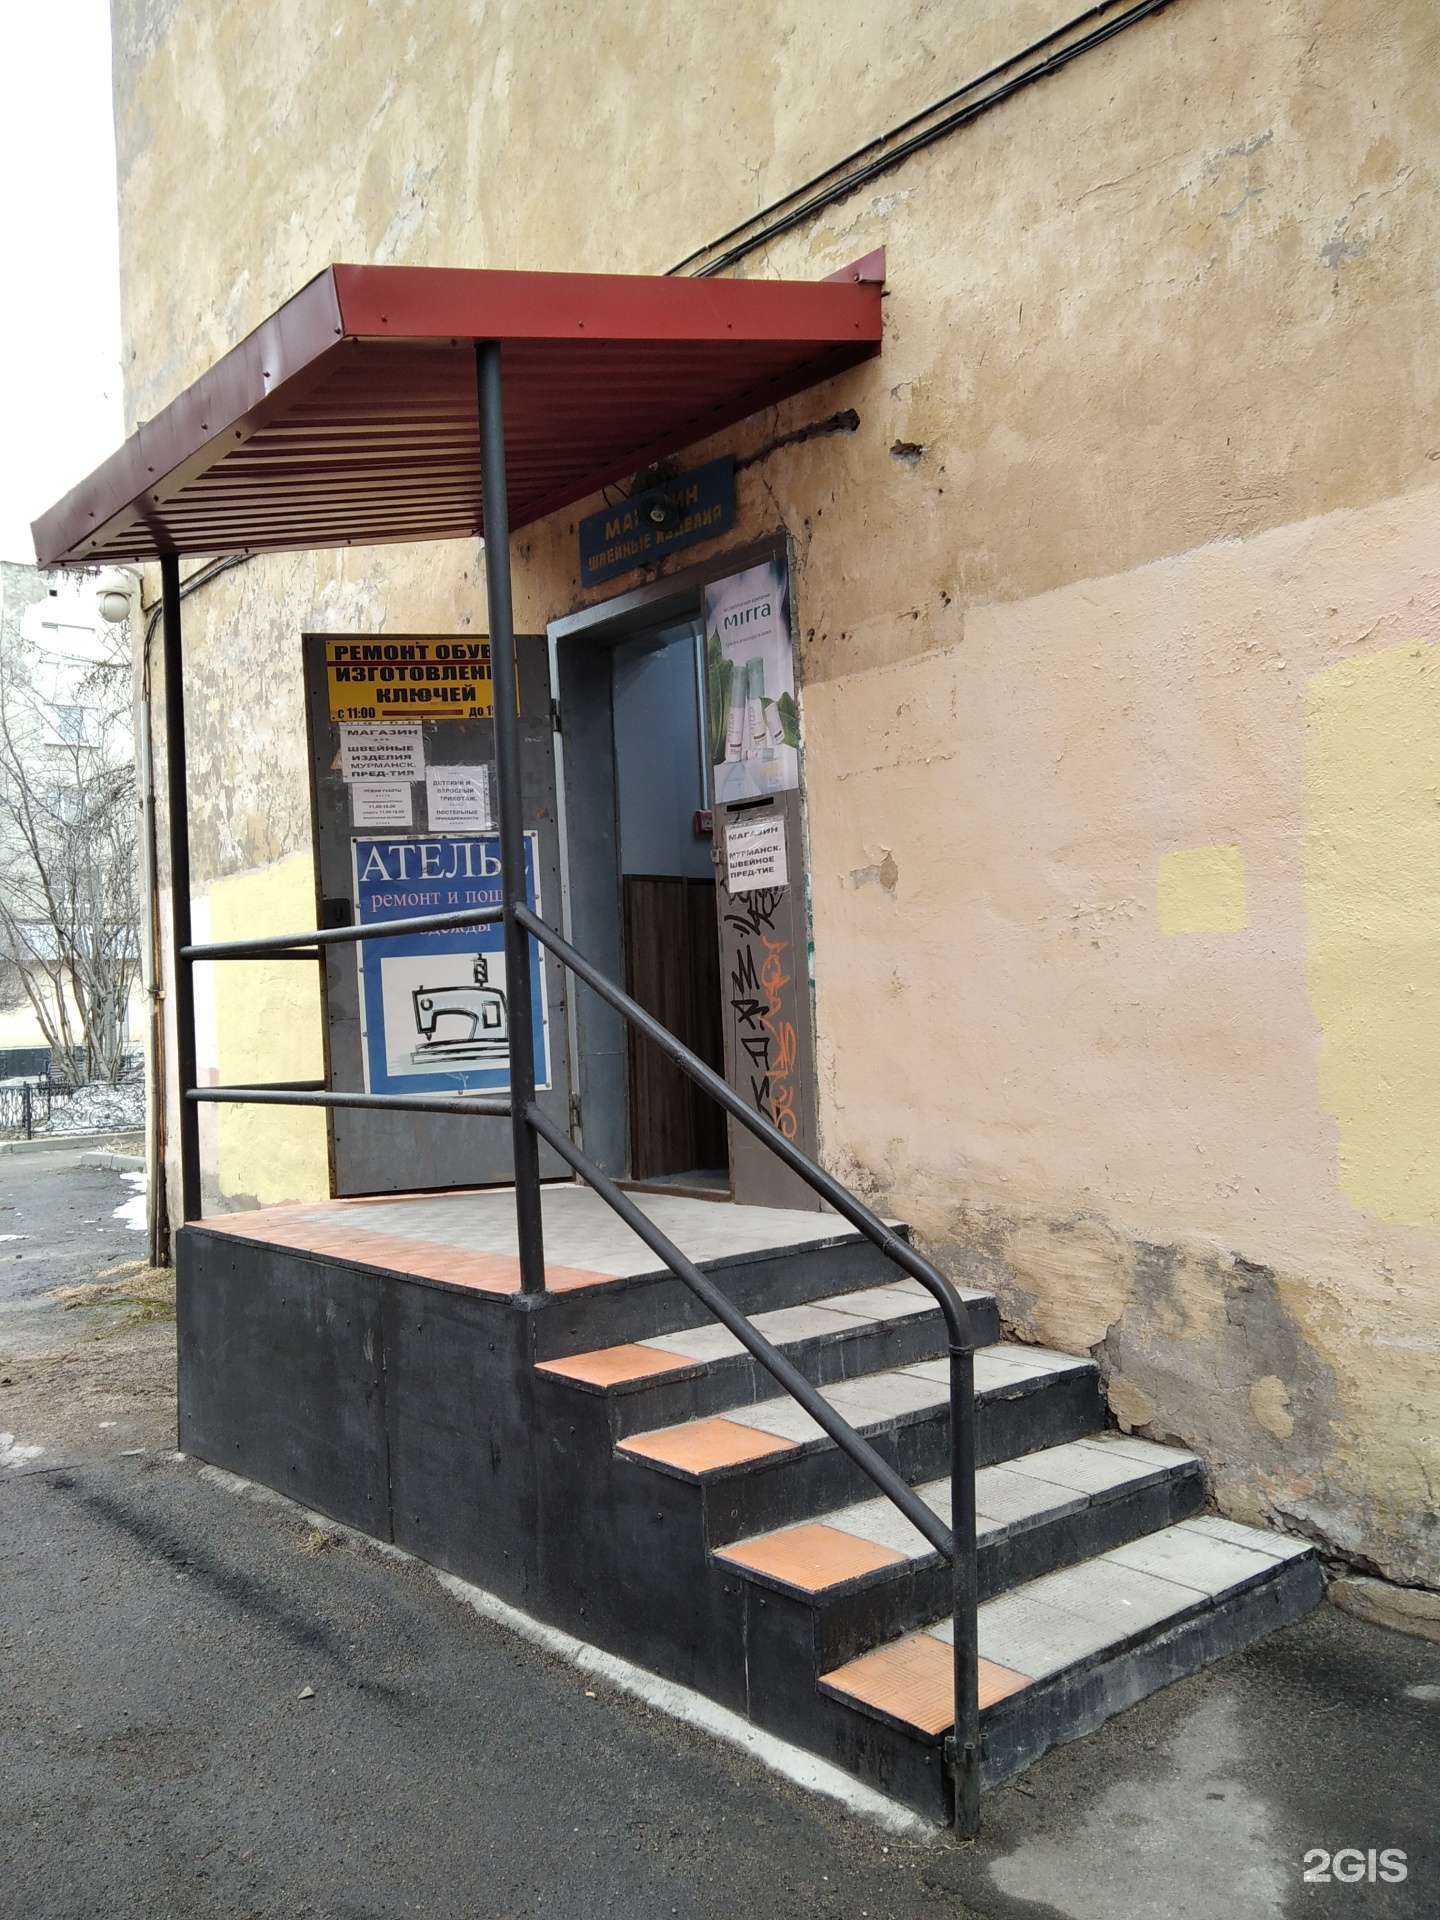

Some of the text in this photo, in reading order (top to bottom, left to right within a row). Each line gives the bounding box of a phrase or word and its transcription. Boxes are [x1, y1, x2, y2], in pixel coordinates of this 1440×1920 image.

[334, 644, 490, 660] РЕМОНТ ОБУВ
[335, 666, 492, 681] ИЗГОТОВЛЕН
[376, 684, 476, 703] КЛЮЧЕЙ
[347, 707, 376, 719] 11:00
[351, 754, 412, 762] ИЗДЕЛИЯ
[359, 843, 529, 882] АТЕЛЬ
[729, 855, 775, 869] ШВЕЙНОЕ
[730, 866, 775, 879] ПРЕД-ТИЕ
[370, 888, 504, 913] ремонт и пош
